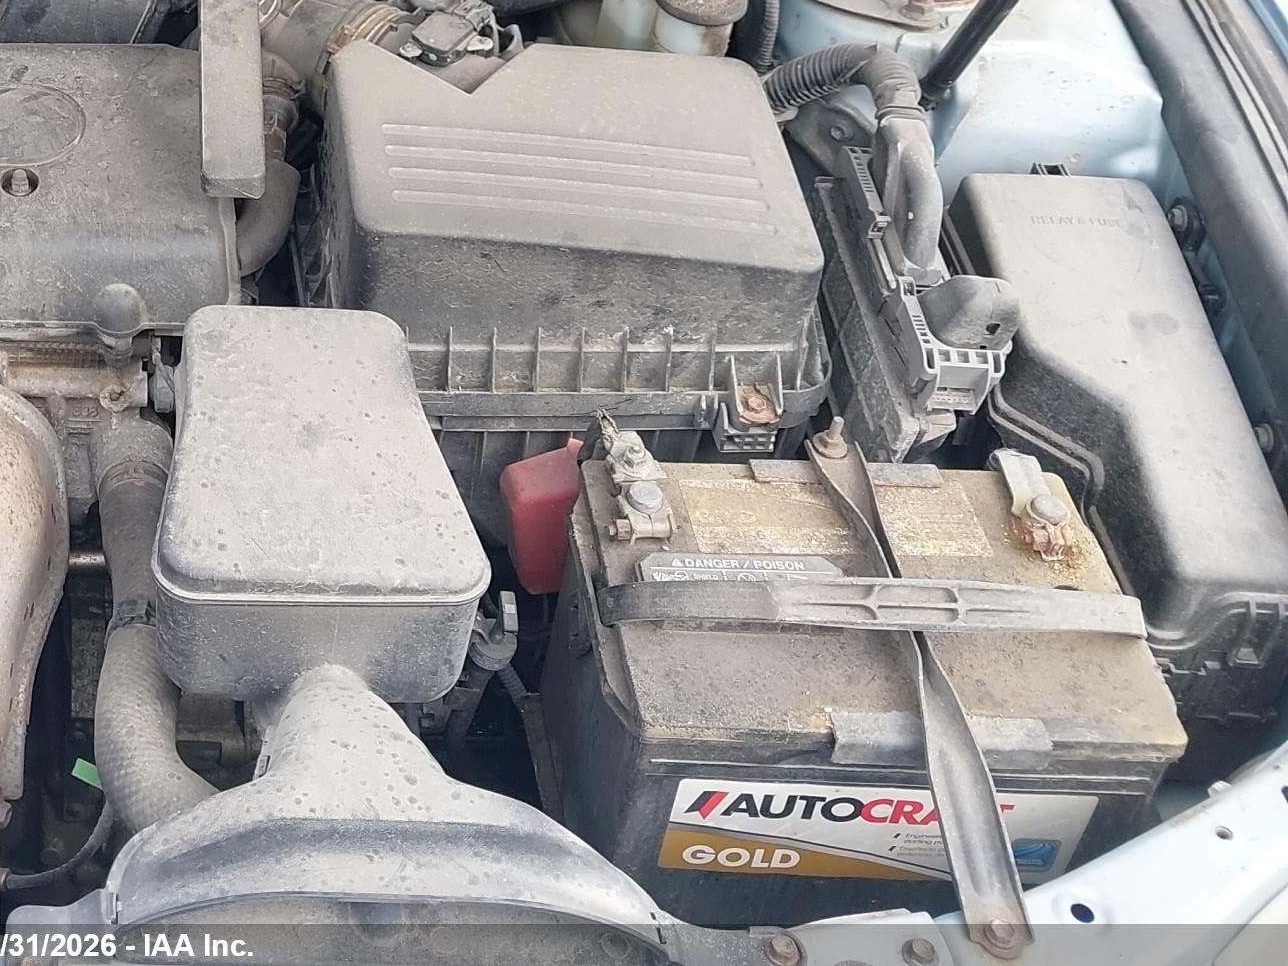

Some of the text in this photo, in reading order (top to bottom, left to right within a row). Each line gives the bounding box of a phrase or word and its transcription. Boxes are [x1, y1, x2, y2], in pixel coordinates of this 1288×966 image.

[685, 558, 739, 569] DANGER
[754, 560, 805, 571] POISON
[720, 792, 1015, 825] AUTOCR
[682, 844, 801, 868] GOLD
